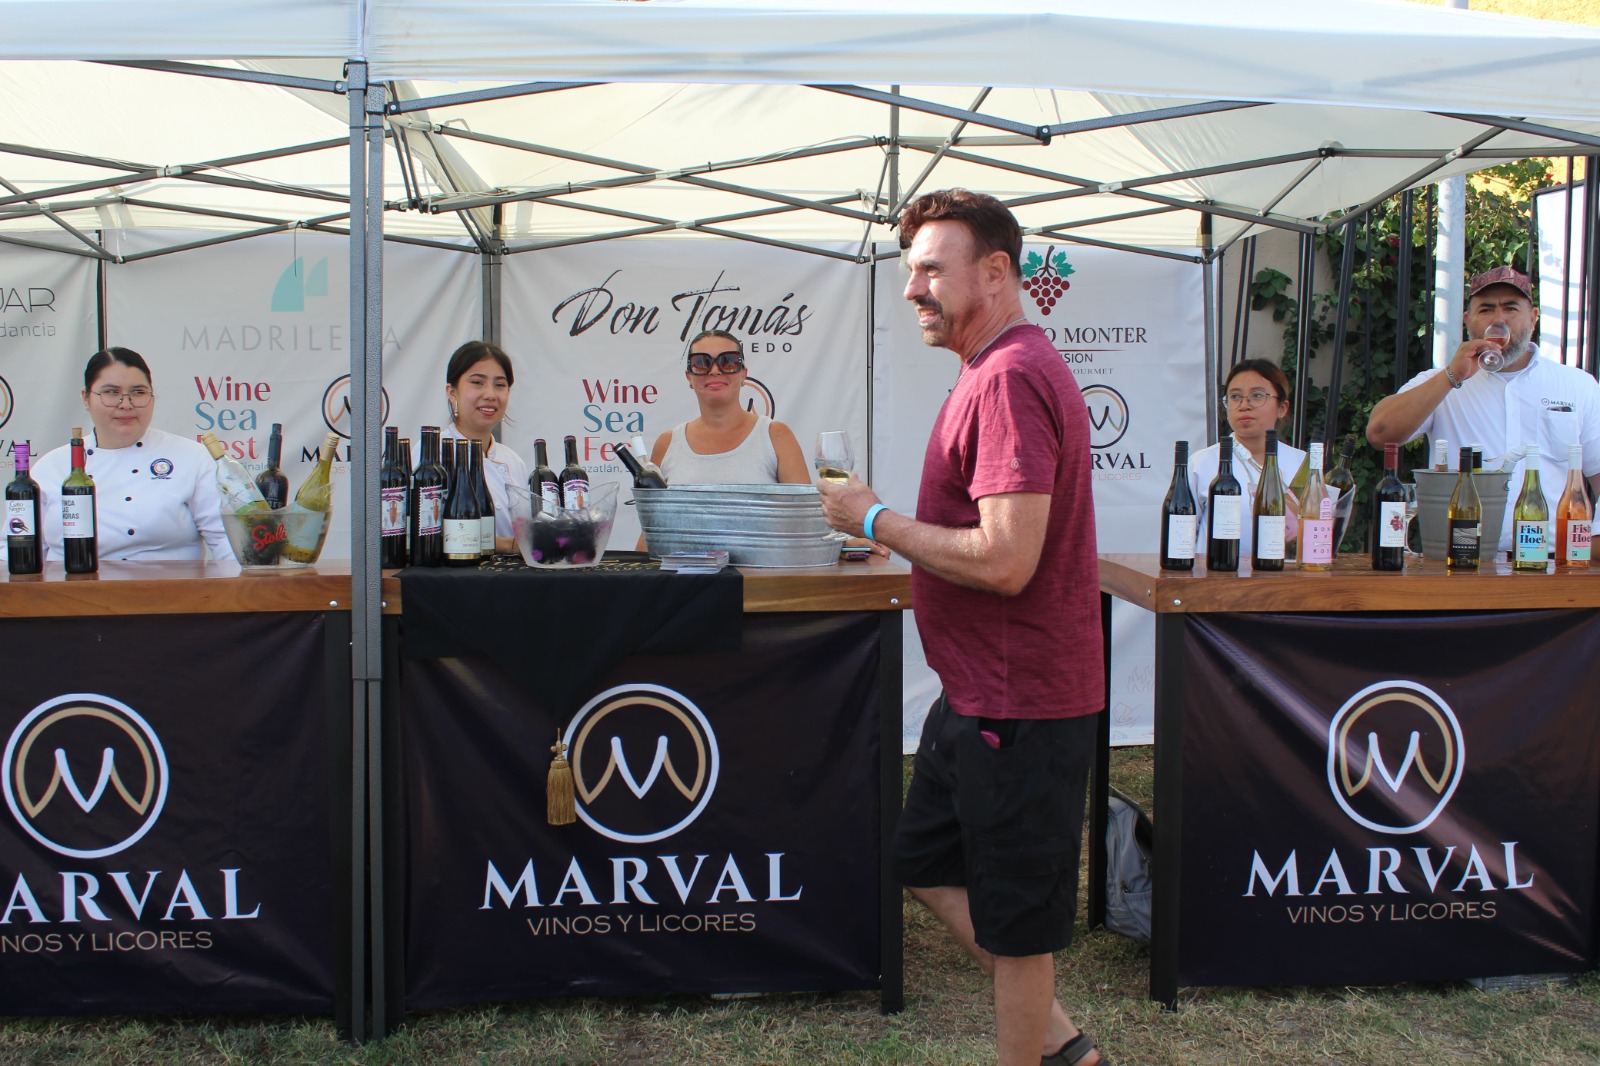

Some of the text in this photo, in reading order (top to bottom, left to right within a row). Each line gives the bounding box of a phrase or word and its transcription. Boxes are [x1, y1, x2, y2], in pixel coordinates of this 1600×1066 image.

[552, 270, 815, 364] Don Tomás
[182, 325, 402, 351] MADRILEA
[739, 340, 792, 353] EDO
[1064, 327, 1148, 344] MONTER
[1062, 353, 1093, 364] SION
[194, 376, 271, 402] Wine
[582, 379, 658, 404] Wine
[195, 402, 257, 431] Sea
[583, 404, 644, 433] Sea
[582, 463, 623, 474] azatlán,
[1090, 452, 1152, 470] RVAL
[252, 523, 287, 550] Stoli
[1520, 525, 1543, 534] Fish
[1520, 534, 1547, 544] Hoek
[1572, 534, 1592, 543] Hoe
[1242, 841, 1534, 897] MARVAL
[478, 852, 803, 910] MARVAL
[1287, 901, 1498, 924] VINOS Y LICORES
[527, 913, 756, 935] VINOS Y LICORES
[68, 933, 85, 951] Y
[92, 930, 213, 951] LICORES
